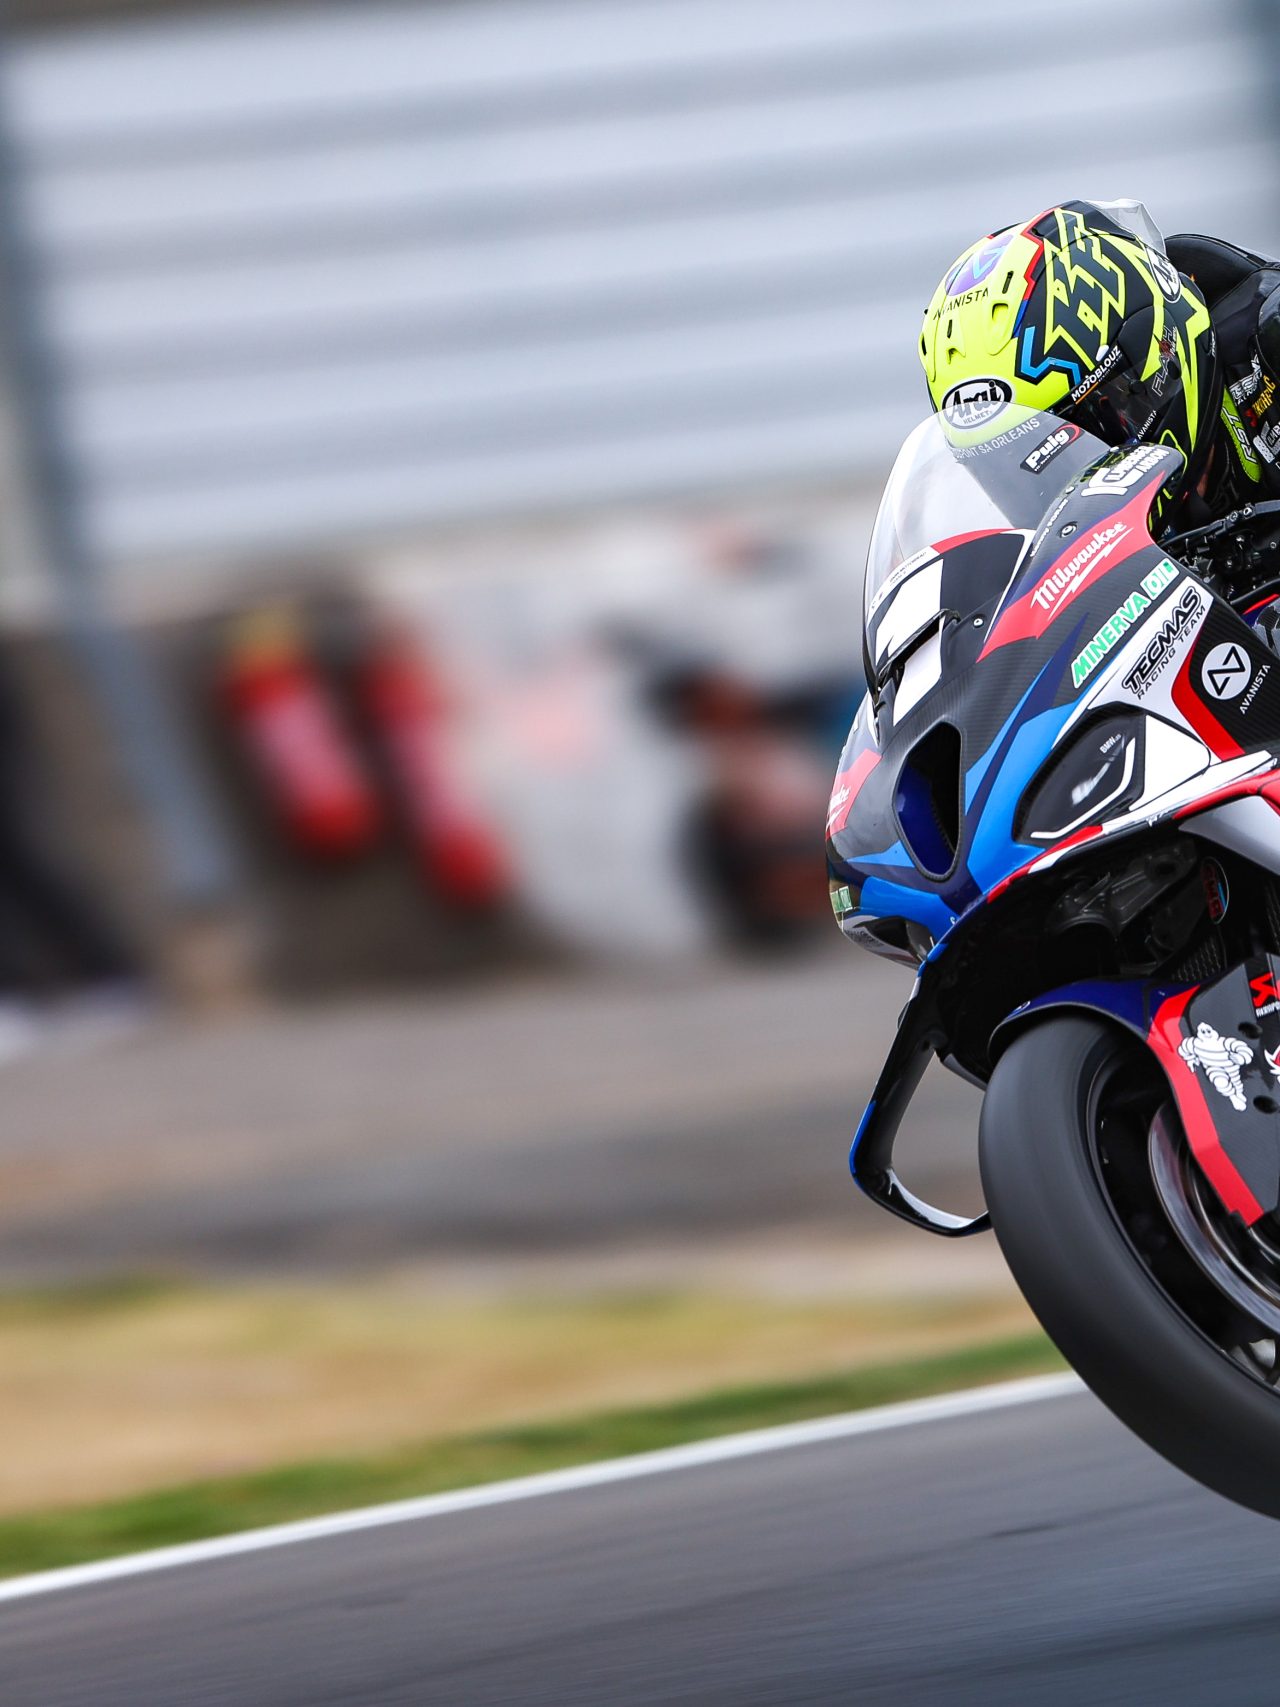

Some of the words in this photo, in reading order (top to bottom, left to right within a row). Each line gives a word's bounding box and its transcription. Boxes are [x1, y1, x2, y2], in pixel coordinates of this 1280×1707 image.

[951, 379, 1000, 418] Arai
[1071, 345, 1121, 401] MOTOBLOUZ
[994, 417, 1040, 450] ORLEANS
[1025, 429, 1070, 469] Puig
[1030, 521, 1128, 609] Milwaukee
[1074, 591, 1149, 687] MINERVA
[1122, 586, 1200, 694] TECMAS
[1137, 648, 1175, 700] RACING
[1179, 605, 1206, 643] TEAM
[1239, 664, 1271, 715] AVANISTA
